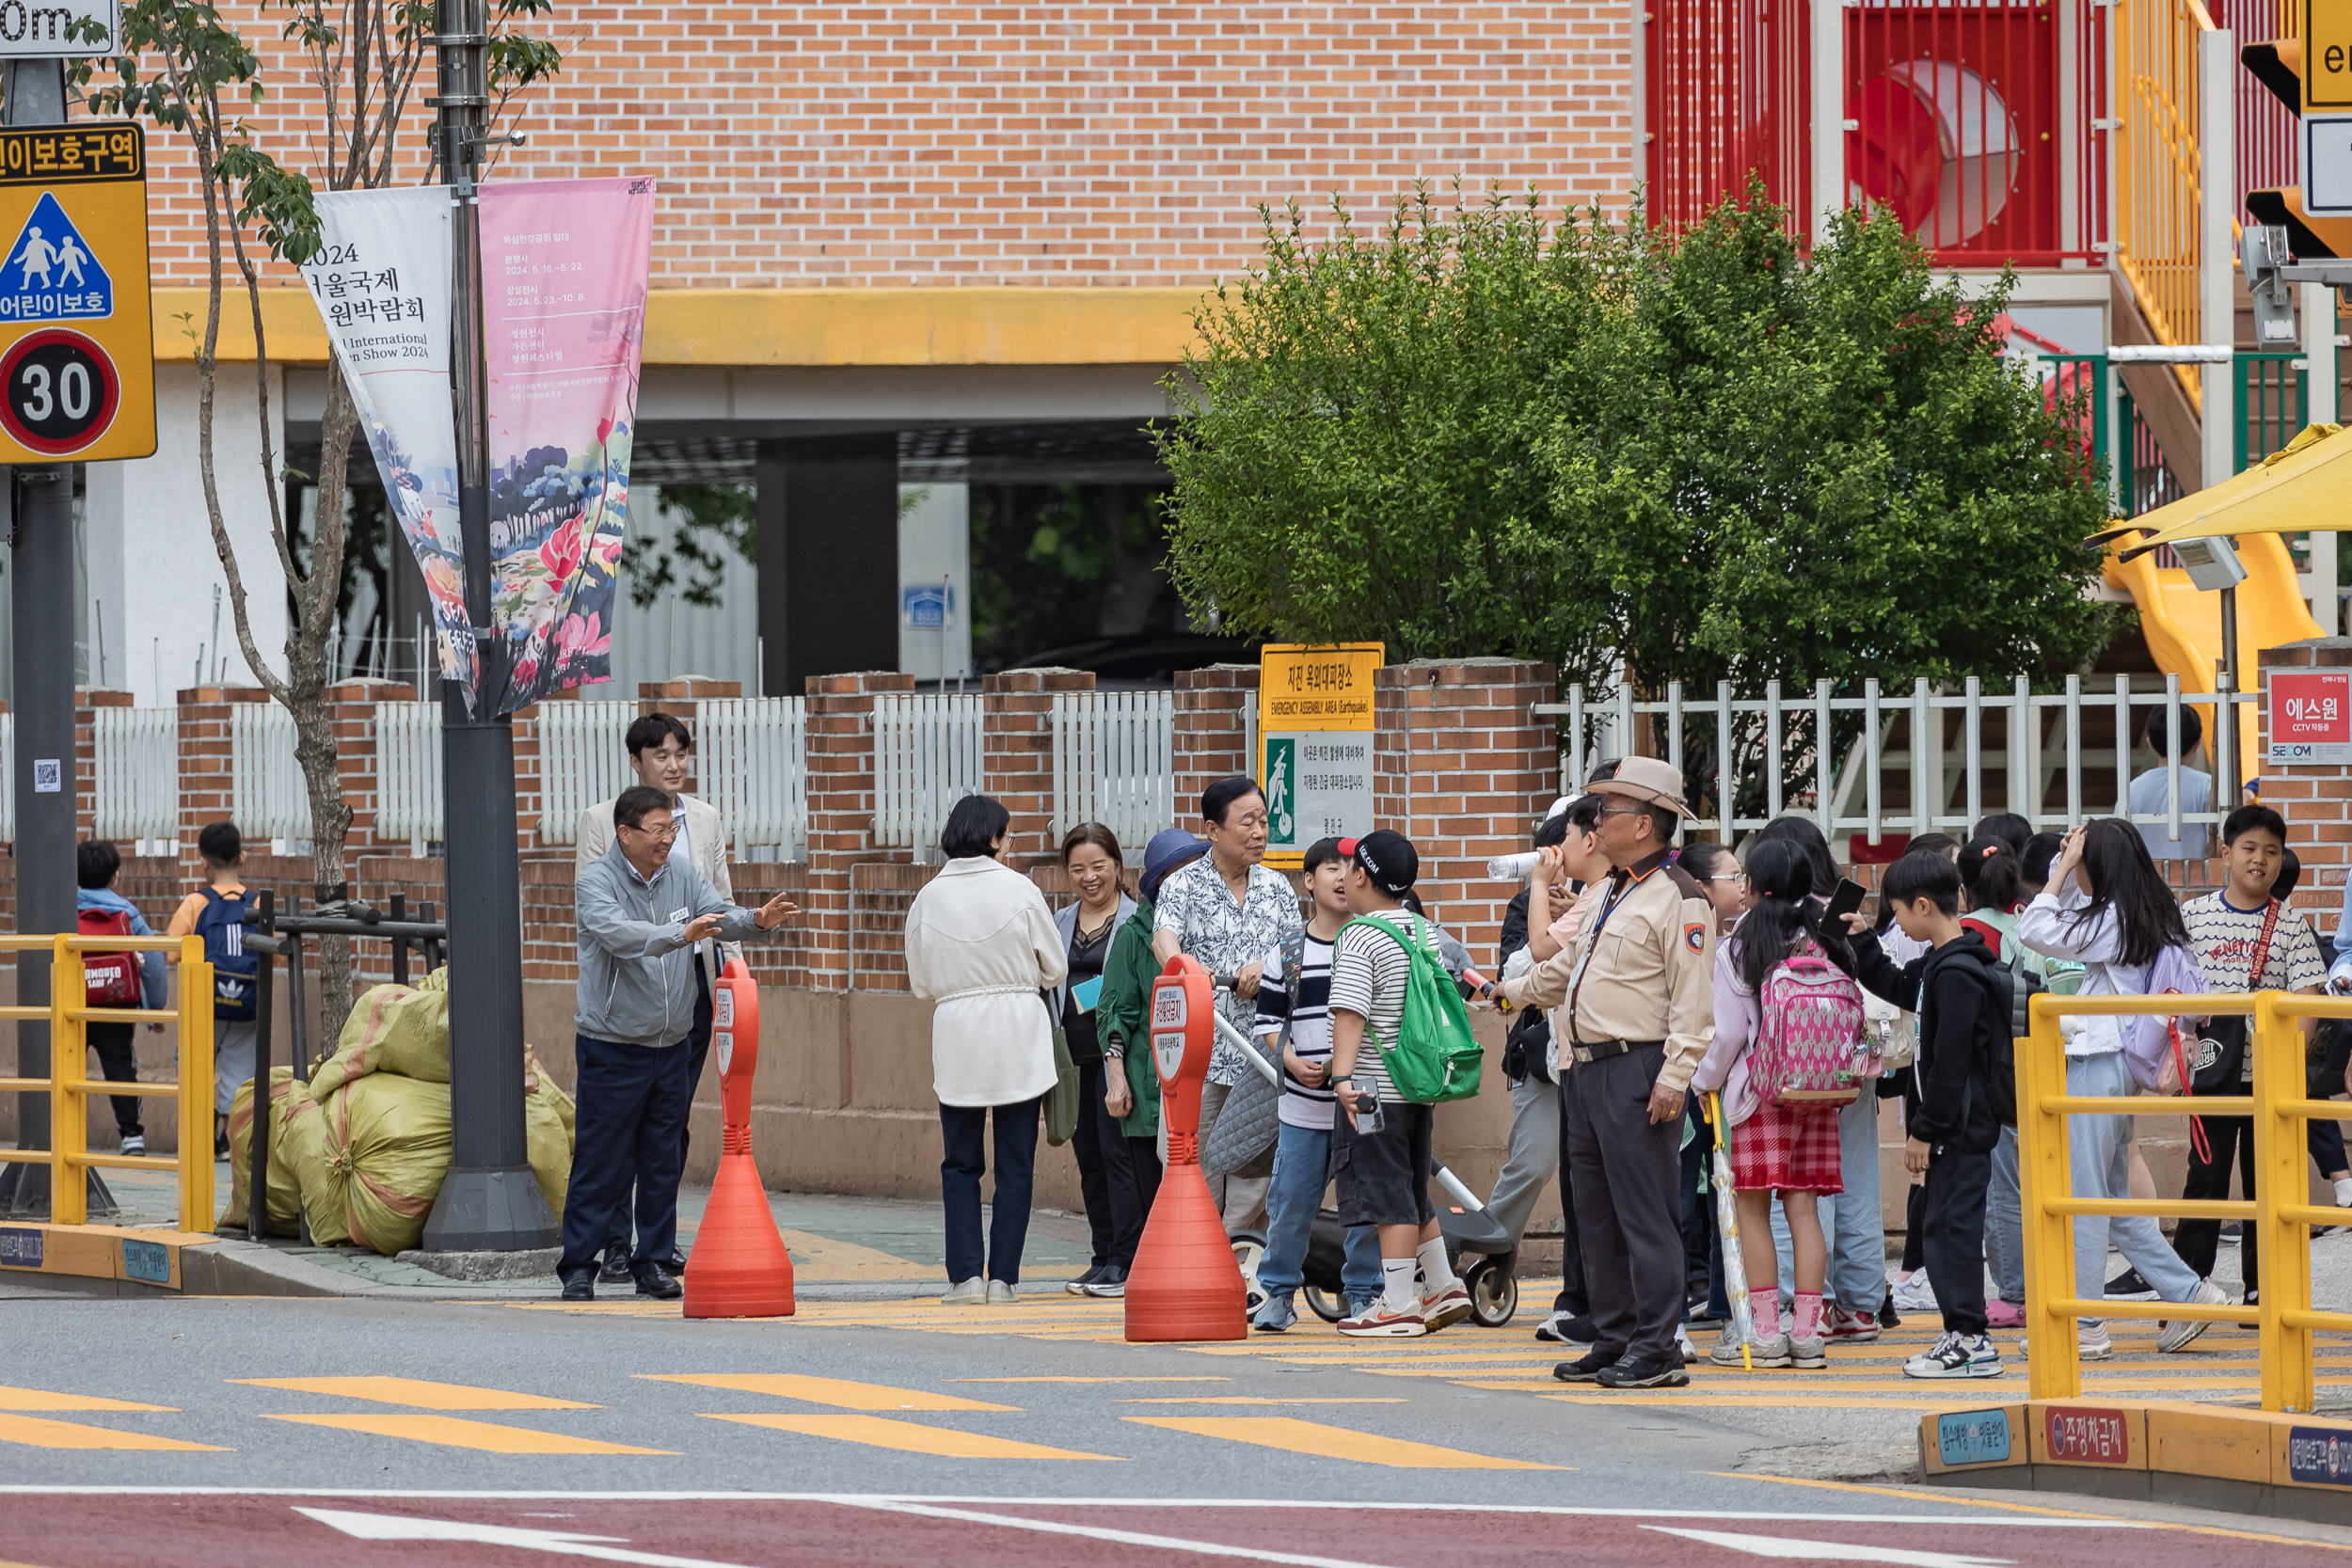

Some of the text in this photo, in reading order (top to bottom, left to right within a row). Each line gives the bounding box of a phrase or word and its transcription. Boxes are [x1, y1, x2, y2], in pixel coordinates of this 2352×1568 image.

[0, 292, 105, 319] 어린이보호
[349, 332, 428, 349] International
[363, 348, 398, 360] Show
[401, 345, 429, 357] 2024
[22, 362, 90, 421] 30
[1288, 663, 1353, 693] 지진 옥외대피장소
[1271, 701, 1297, 715] EMERGENCY
[1300, 700, 1324, 714] ASSEMBLY
[1325, 699, 1337, 714] AREA
[2285, 697, 2338, 721] 에스원
[2292, 723, 2311, 732] CCTV
[1303, 745, 1317, 761] 이곳은
[1330, 745, 1343, 761] 발생에
[1345, 745, 1364, 761] 대비하여
[2272, 745, 2312, 756] SECOM
[1319, 774, 1328, 790] 긴급
[1359, 845, 1380, 874] LGE.COM
[2066, 1416, 2122, 1457] 주정차금지
